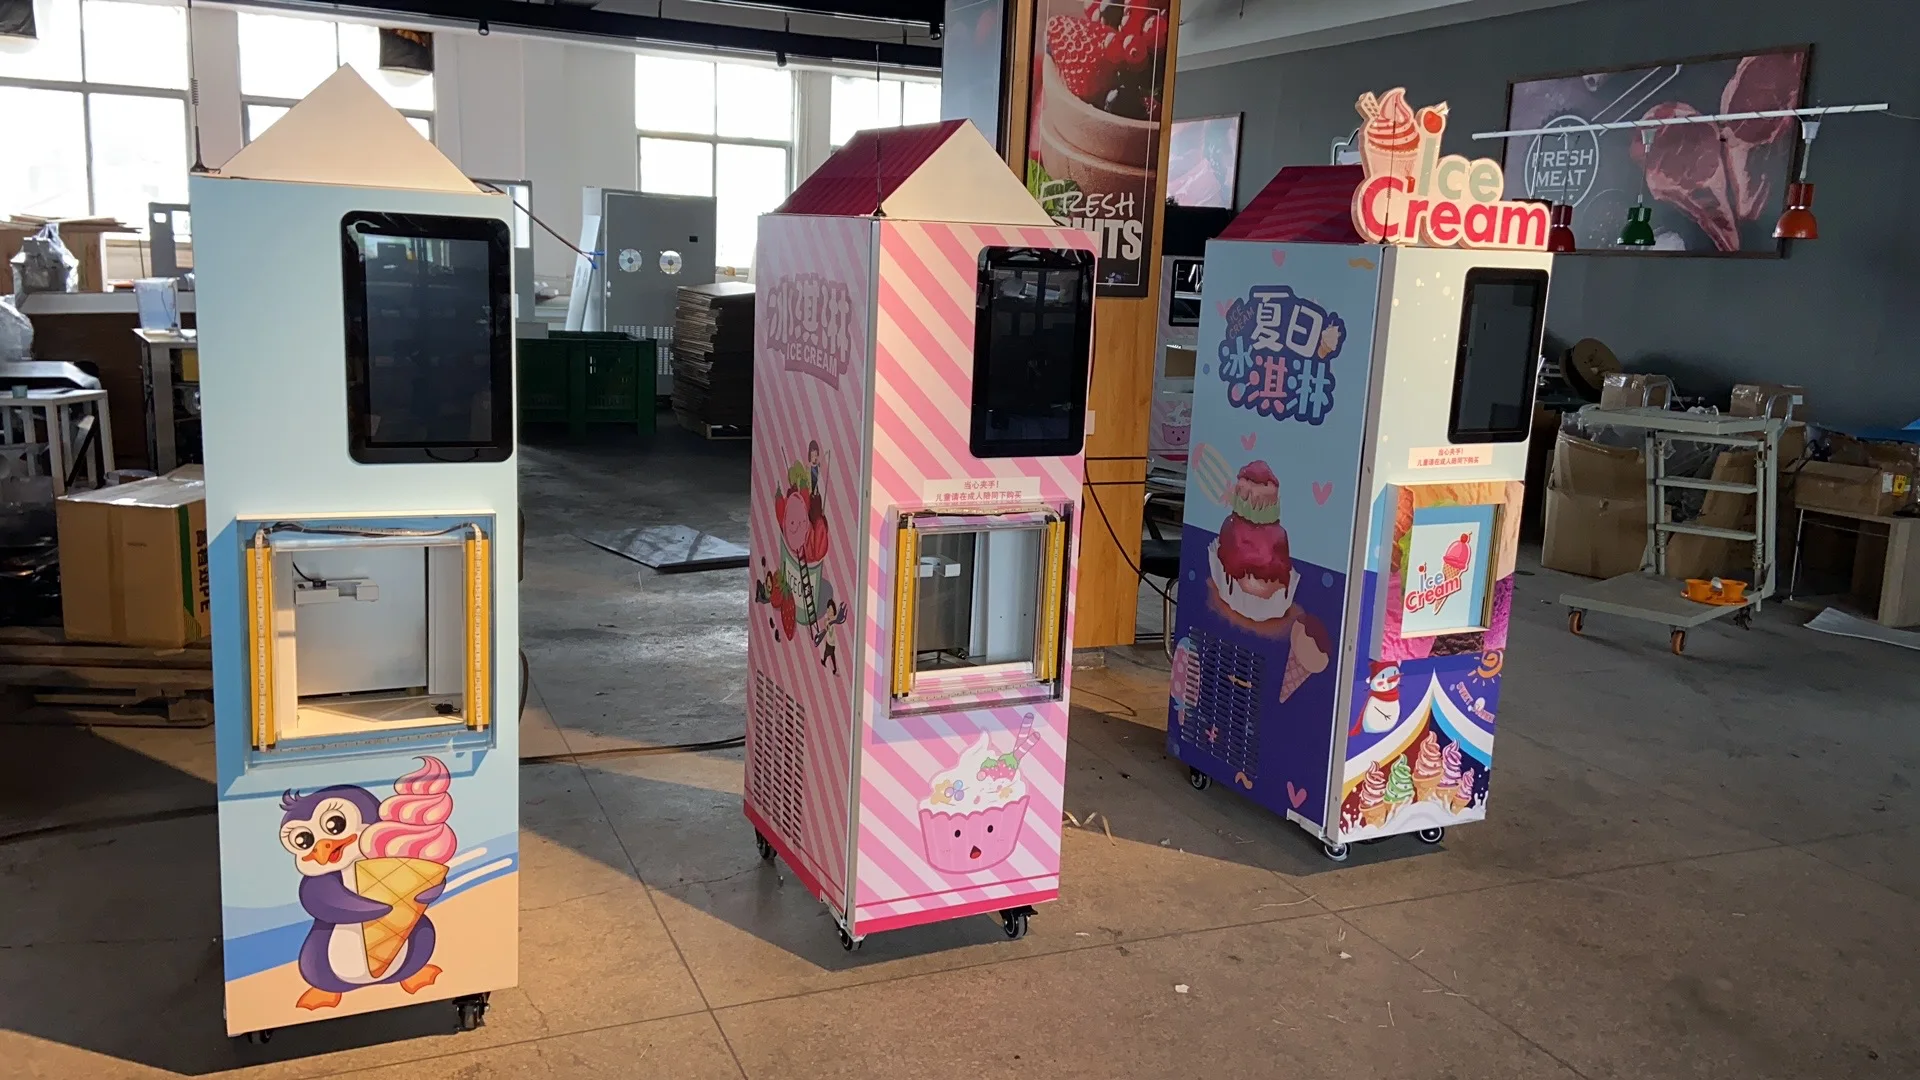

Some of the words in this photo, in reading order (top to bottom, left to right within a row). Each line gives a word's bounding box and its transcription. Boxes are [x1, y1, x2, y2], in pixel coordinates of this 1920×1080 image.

[1531, 149, 1594, 168] FRESH
[1536, 169, 1587, 187] MEAT
[1038, 179, 1135, 218] FRESH
[1362, 176, 1548, 247] Cream
[1051, 216, 1142, 260] ITS
[768, 280, 849, 363] 冰淇淋
[1251, 292, 1323, 358] 夏日
[786, 343, 802, 360] ICE
[803, 345, 838, 378] CREAM
[1222, 336, 1329, 418] 冰淇淋
[936, 490, 1022, 503] 儿童请在成人陪同下购买
[1405, 576, 1459, 611] Cream
